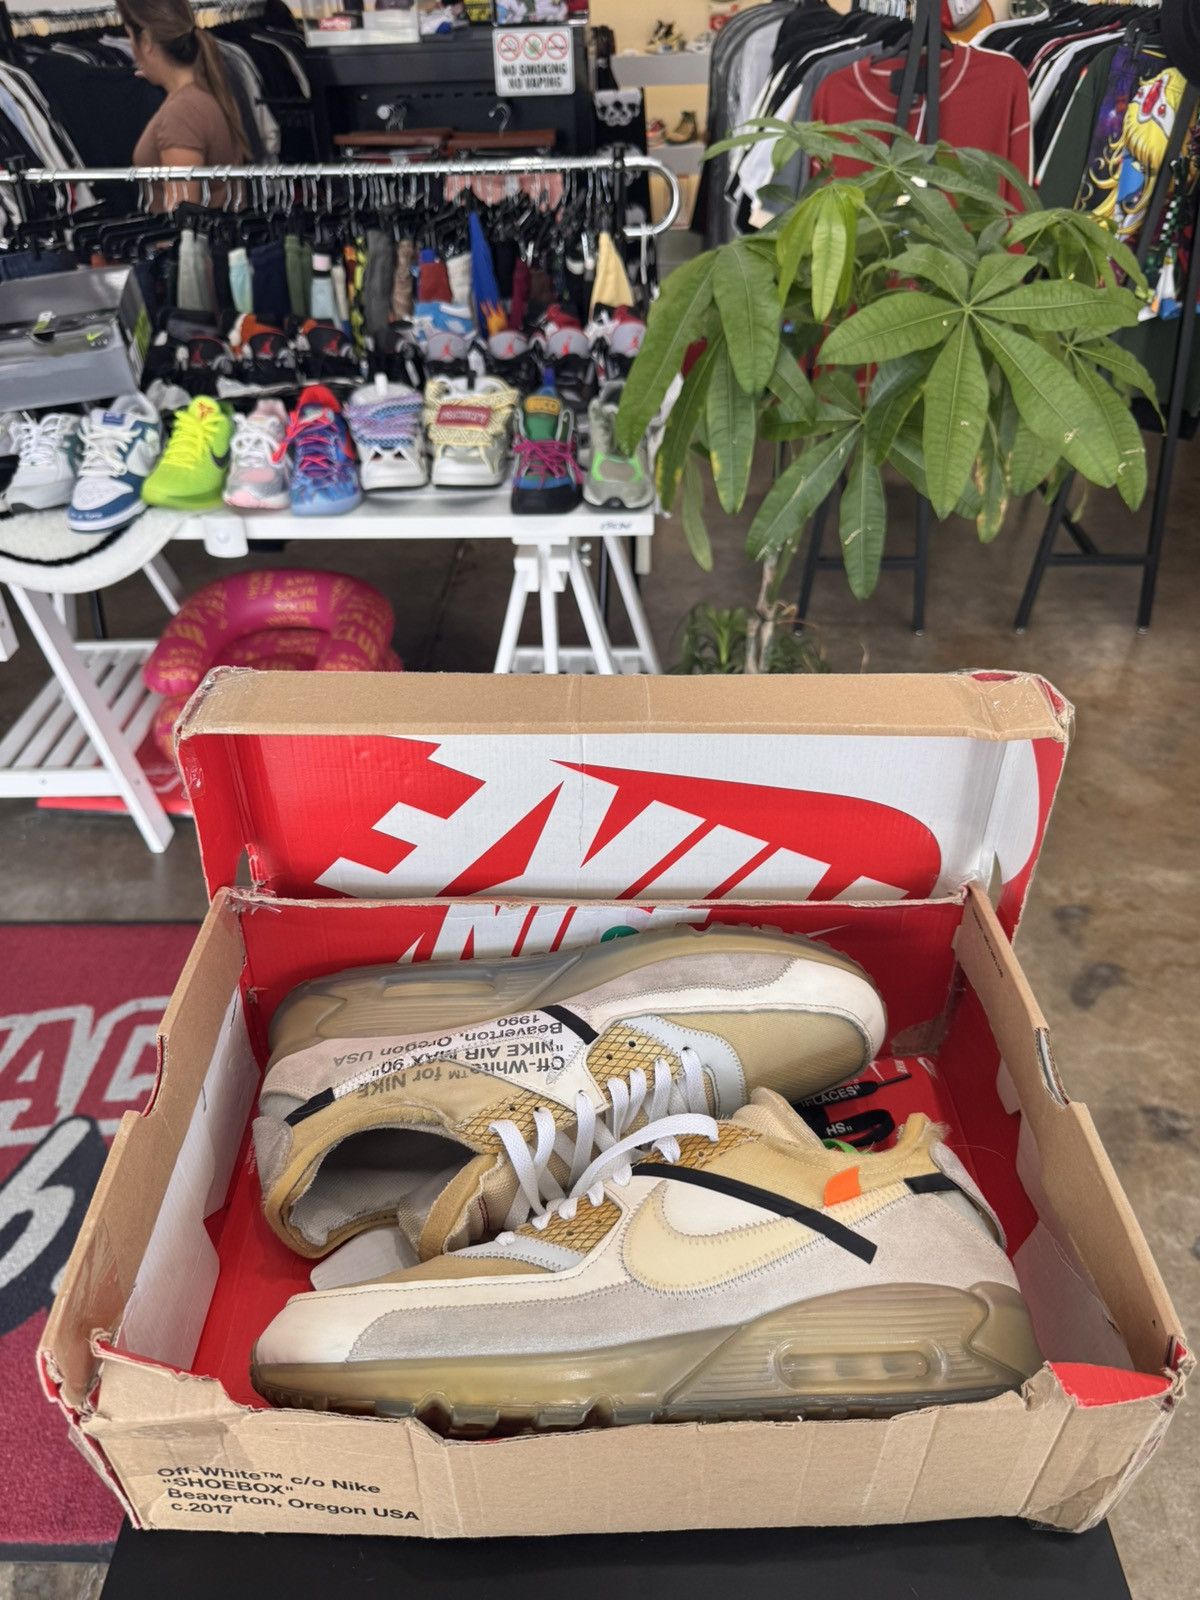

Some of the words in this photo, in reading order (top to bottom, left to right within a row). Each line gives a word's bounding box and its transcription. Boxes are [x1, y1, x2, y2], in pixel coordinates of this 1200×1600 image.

[502, 64, 516, 76] NO
[519, 63, 567, 76] SMOKING
[508, 78, 521, 89] NO
[525, 76, 562, 89] VAPING
[497, 1014, 540, 1027] 1990
[459, 1022, 563, 1043] Beaverton,
[380, 1036, 452, 1058] Oregon
[465, 1046, 501, 1061] AIR
[507, 1039, 564, 1059] "NIKE
[332, 1051, 374, 1068] USA
[371, 1058, 405, 1077] 90"
[413, 1067, 442, 1082] for
[357, 1073, 407, 1099] NIKE
[162, 1477, 294, 1495] "SHOEBOX"
[290, 1475, 325, 1488] c/o
[332, 1480, 381, 1494] Nike
[167, 1487, 283, 1508] Beaverton,
[288, 1498, 367, 1517] Oregon
[373, 1507, 420, 1521] USA
[171, 1502, 234, 1515] c.2017
